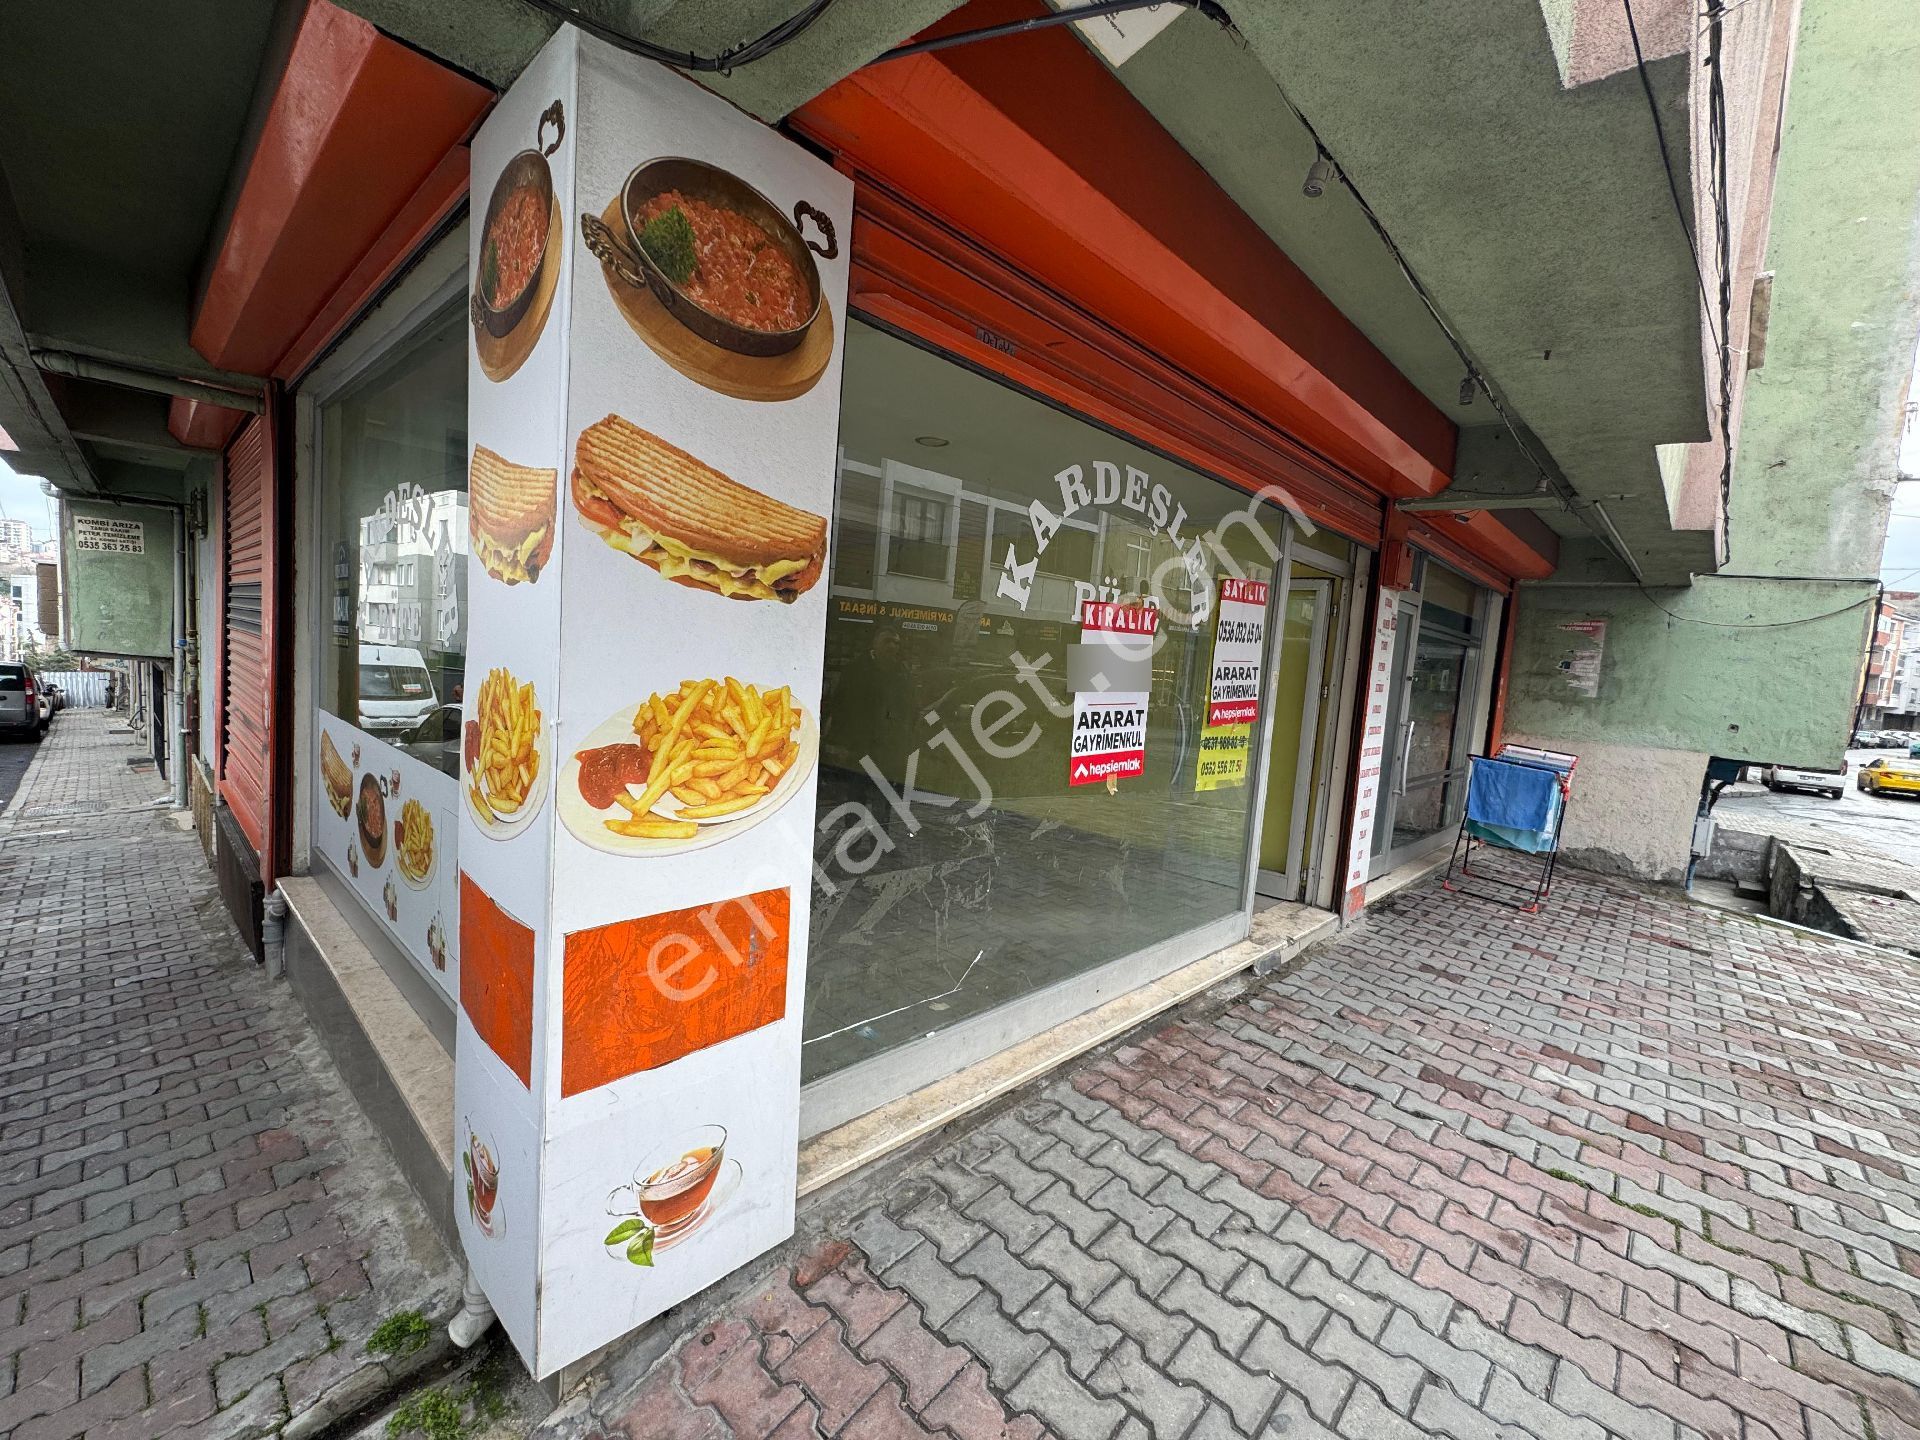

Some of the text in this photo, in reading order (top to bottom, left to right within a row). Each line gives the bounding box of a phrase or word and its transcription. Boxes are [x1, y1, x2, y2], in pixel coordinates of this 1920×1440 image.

[79, 541, 99, 549] 0535
[102, 542, 117, 550] 363
[132, 545, 142, 553] 83
[996, 460, 1210, 631] KARDEŞLER
[1224, 580, 1266, 602] SATILIK
[1214, 666, 1259, 681] ARARAT
[1212, 680, 1257, 700] GAYRİMENKUL
[1077, 709, 1144, 730] ARARAT
[1221, 706, 1256, 721] hepsiemlak
[1073, 728, 1143, 753] GAYRİMENKUL
[1090, 757, 1141, 777] hepsiemlak
